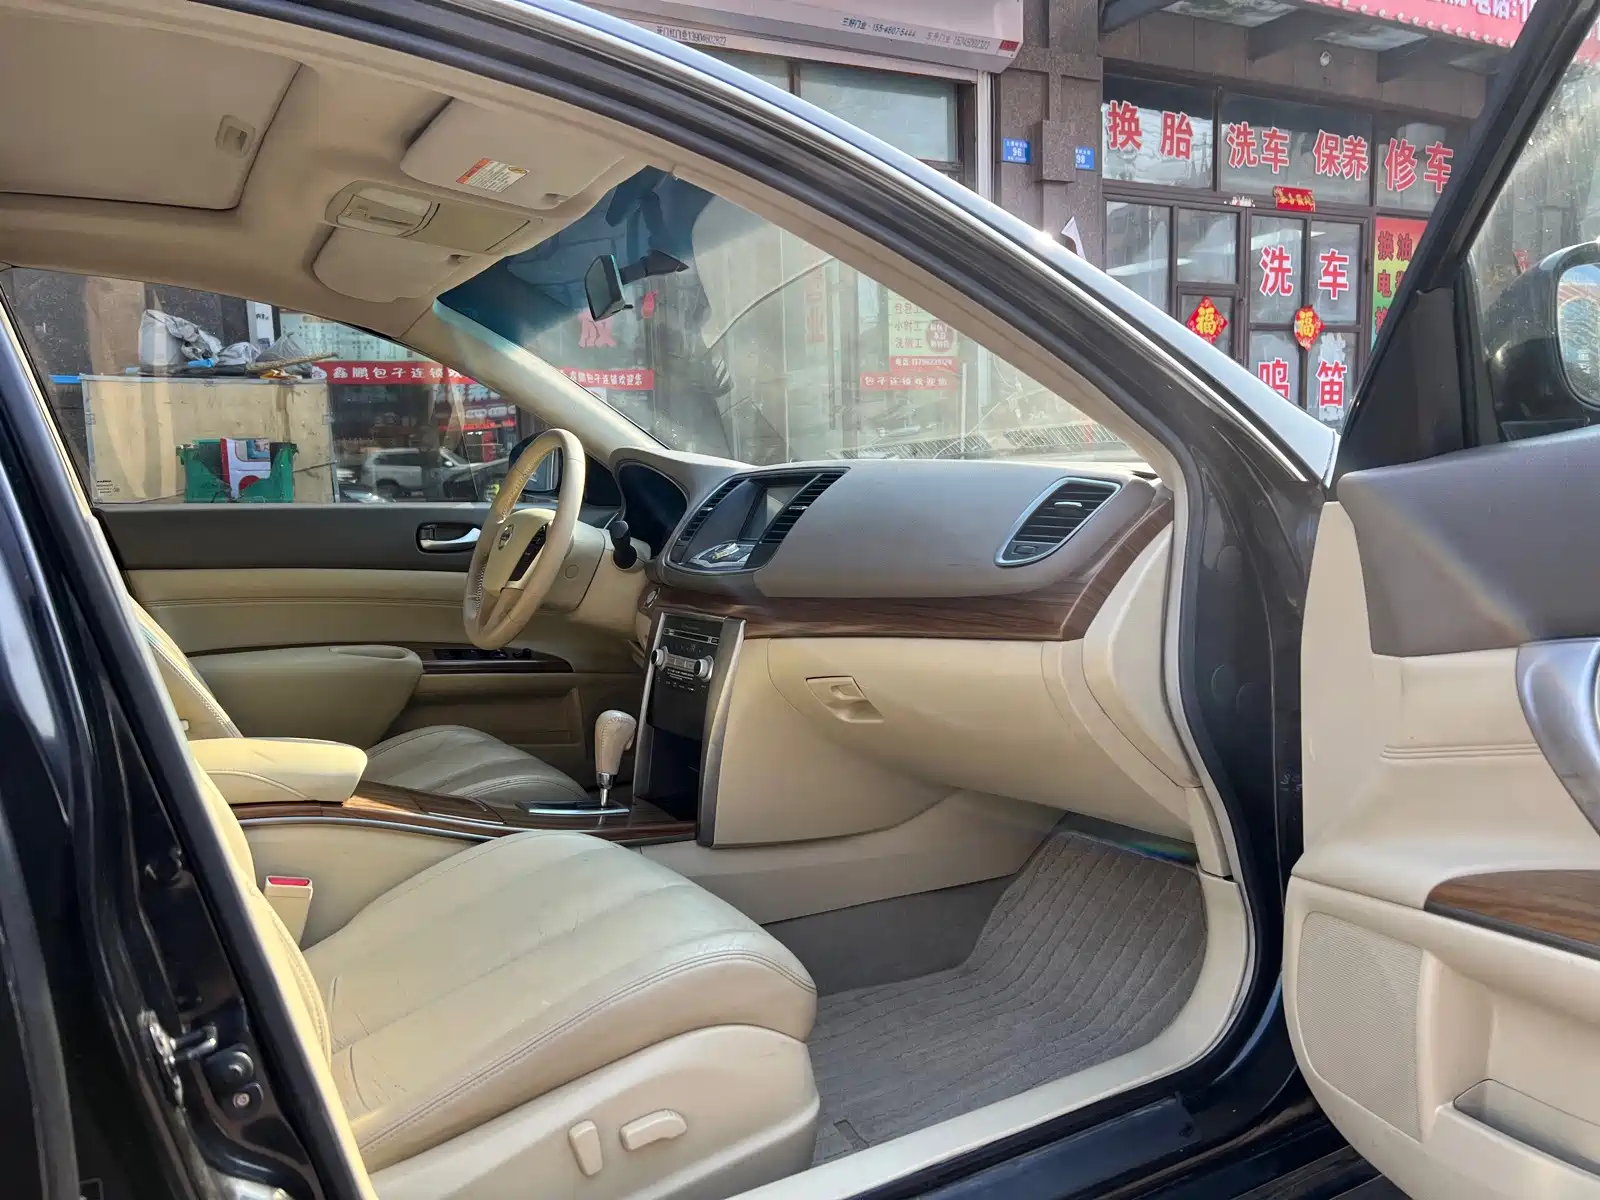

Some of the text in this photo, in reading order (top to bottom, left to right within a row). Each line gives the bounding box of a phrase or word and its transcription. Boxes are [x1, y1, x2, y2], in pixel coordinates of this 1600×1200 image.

[1107, 100, 1454, 194] 换胎 洗车 保养 修车
[1259, 245, 1349, 300] 洗车
[1196, 306, 1217, 335] 福
[1297, 310, 1315, 338] 福
